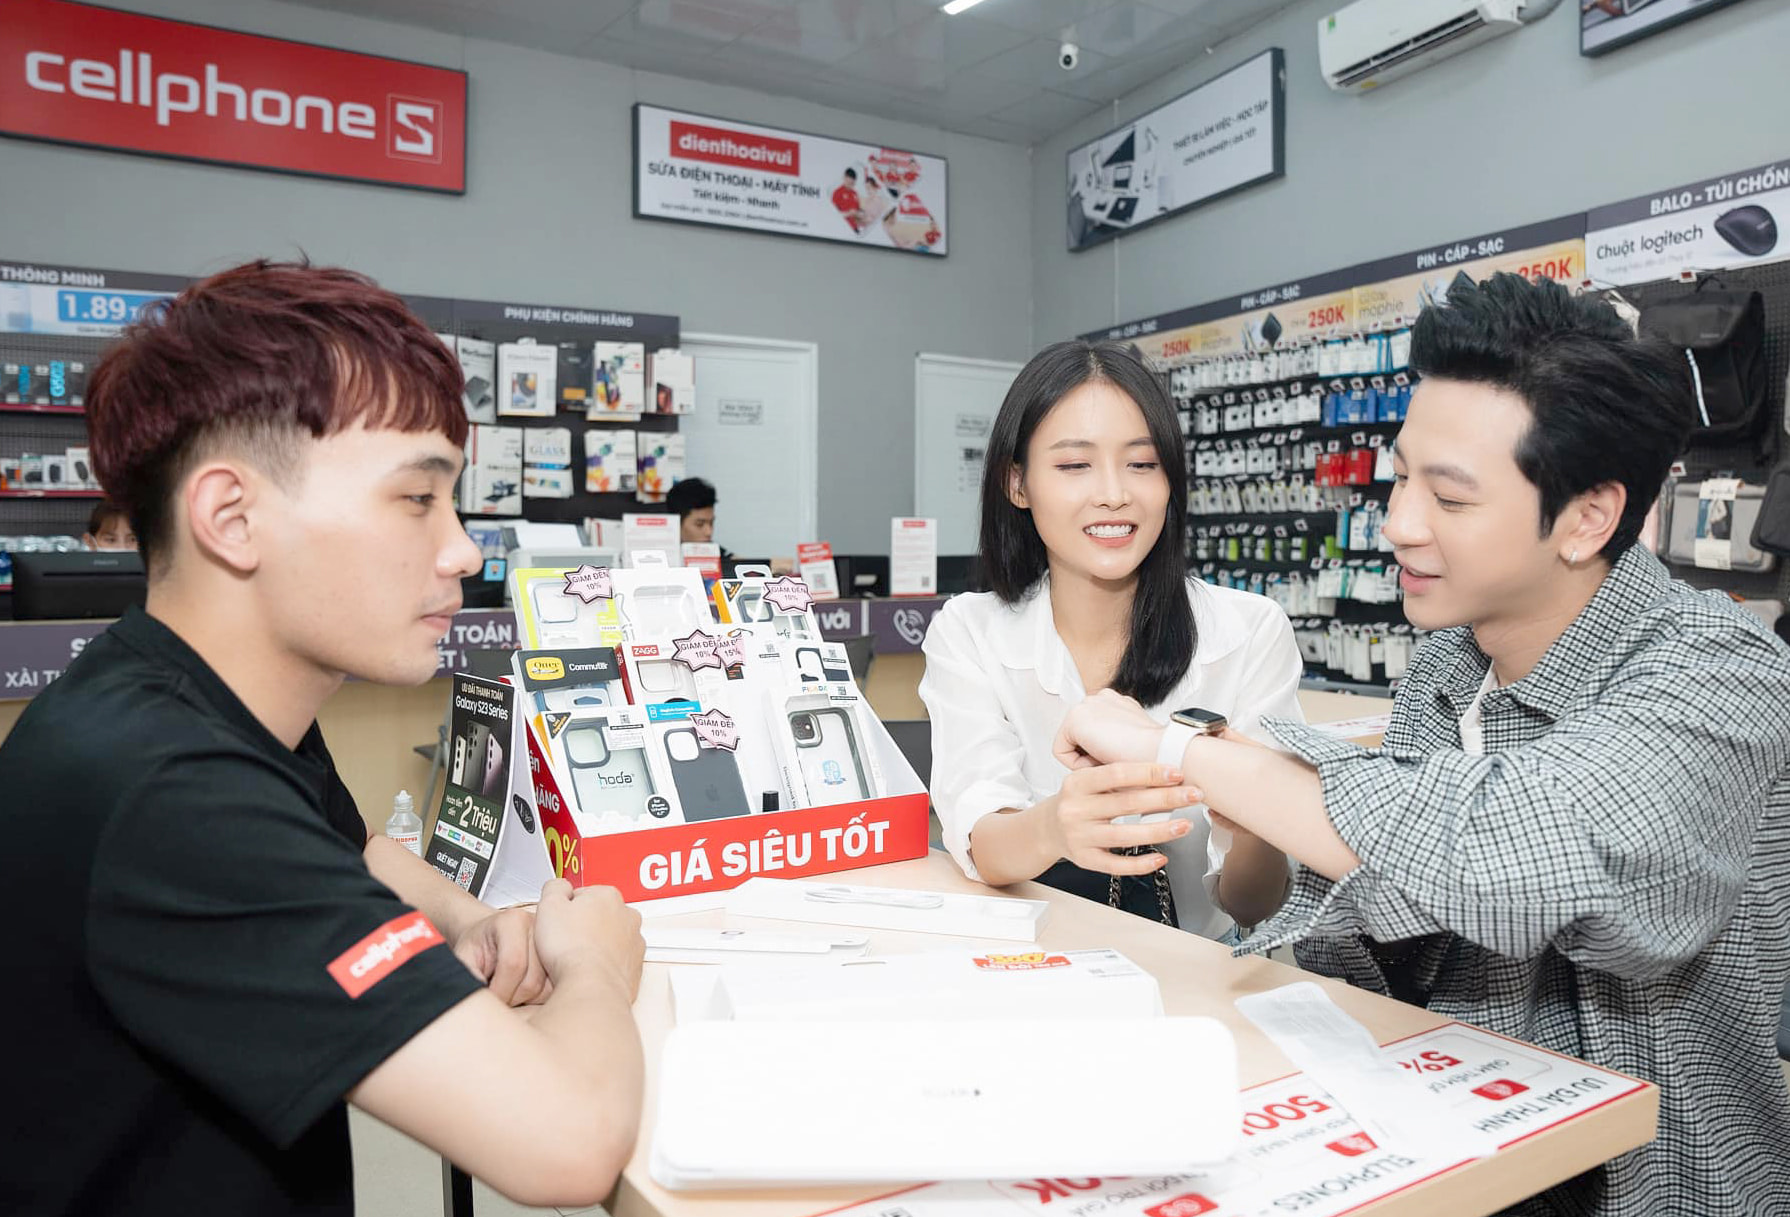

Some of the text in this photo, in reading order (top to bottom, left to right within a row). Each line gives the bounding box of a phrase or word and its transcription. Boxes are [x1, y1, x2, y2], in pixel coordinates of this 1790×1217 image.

[678, 133, 793, 166] dienthoaivui
[763, 178, 788, 194] MÁY
[1650, 191, 1693, 216] BALO
[1705, 179, 1733, 203] TÚI
[1736, 164, 1790, 194] CHỐN
[1416, 253, 1437, 270] PIN
[1444, 243, 1469, 263] CÁP
[1477, 237, 1505, 258] SẠC
[1596, 224, 1704, 261] Chuột logitech
[0, 264, 106, 287] THÔNG MINH
[63, 293, 126, 321] 1.89
[504, 307, 531, 323] PHỤ
[532, 308, 561, 324] KIỆN
[562, 310, 600, 326] CHÍNH
[1308, 304, 1346, 329] 250K
[1162, 339, 1192, 358] 250K
[586, 581, 602, 590] 10%
[454, 619, 513, 644] TOÁN
[633, 646, 657, 655] ZAGG
[695, 650, 711, 658] 10%
[724, 647, 741, 657] 15%
[455, 694, 509, 721] Galaxy S23 Series
[711, 729, 727, 737] 10%
[598, 771, 633, 786] hoda
[459, 795, 474, 829] 2
[472, 805, 498, 838] Triệu
[639, 811, 890, 890] GIÁ SIÊU TỐT
[1472, 1102, 1548, 1133] THANH
[1273, 1154, 1416, 1212] ELLPHONES
